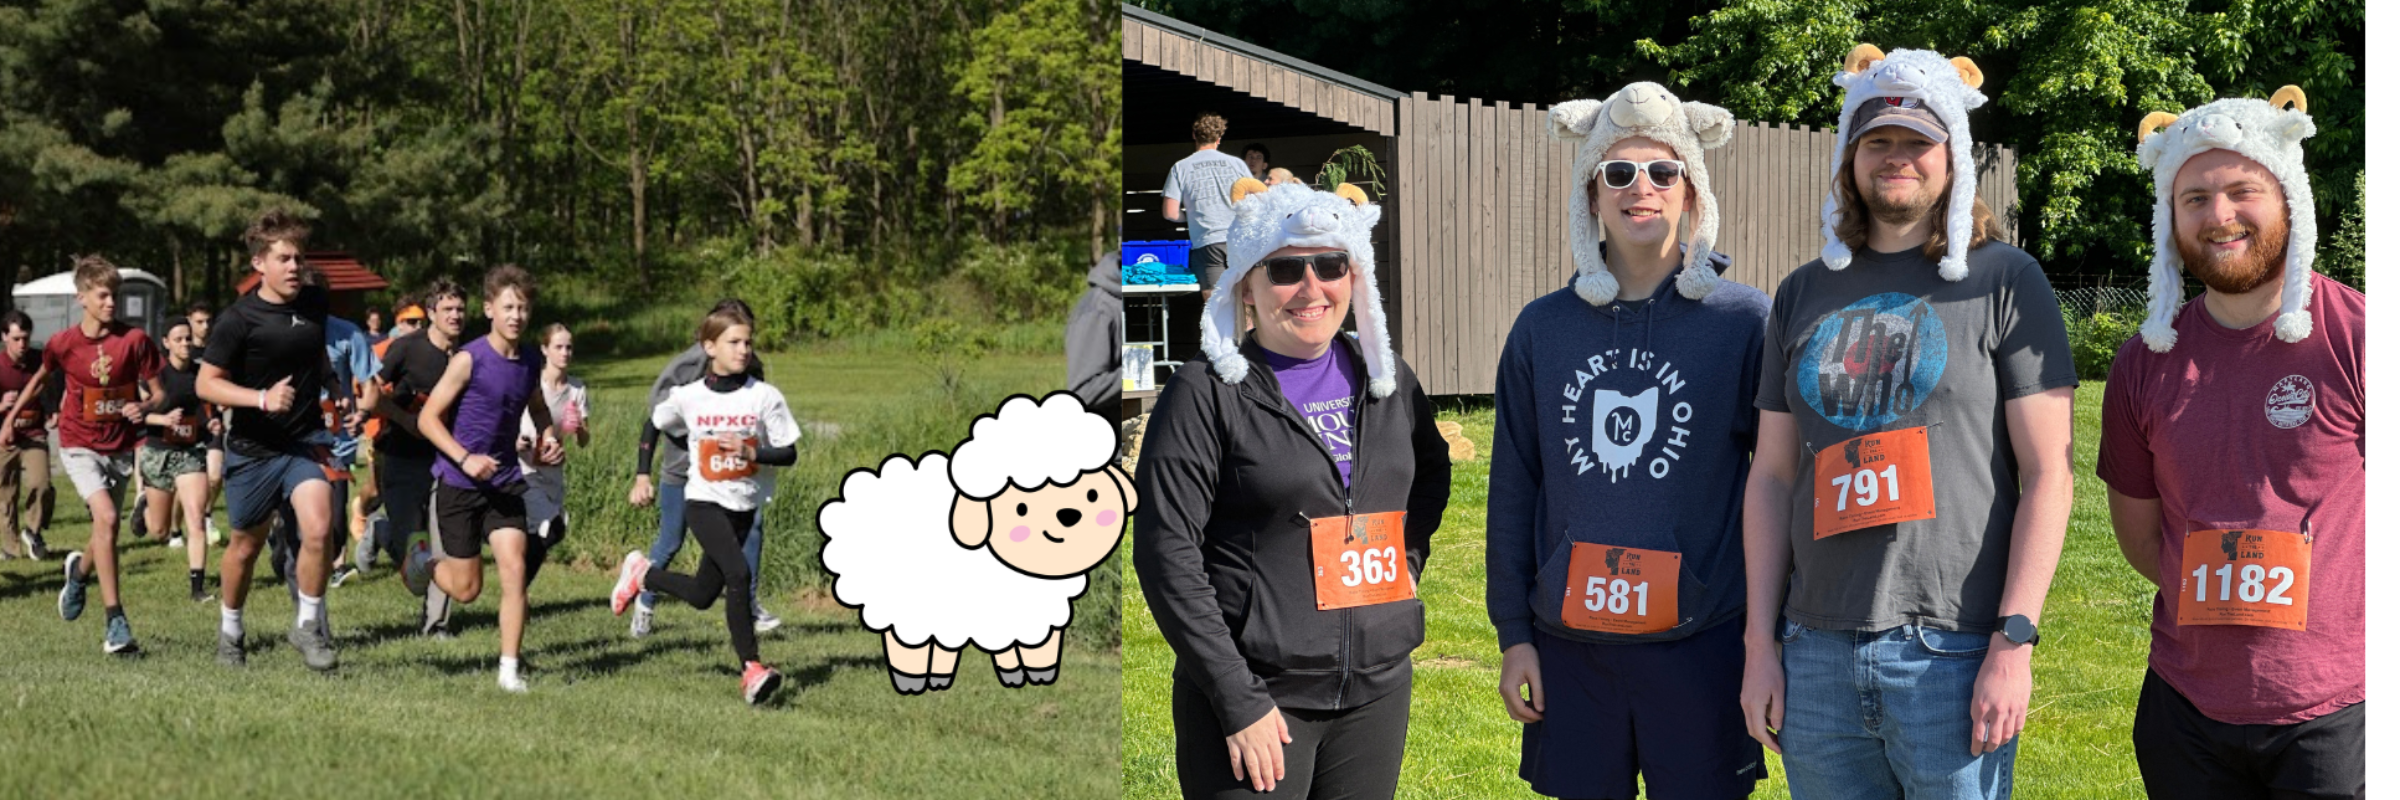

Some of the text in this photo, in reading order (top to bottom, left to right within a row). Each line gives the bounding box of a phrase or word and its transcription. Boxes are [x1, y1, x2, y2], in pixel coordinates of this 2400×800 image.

[1832, 307, 1906, 364] The
[1562, 348, 1693, 479] MY HEART IS IN OHIO
[697, 414, 756, 427] NPXC
[1865, 438, 1881, 447] RUN
[1863, 454, 1885, 464] LAND
[1832, 464, 1899, 512] 791
[2245, 534, 2262, 543] RUN
[1626, 552, 1641, 561] RUN
[2241, 551, 2264, 559] LAND
[1339, 546, 1397, 587] 363
[1621, 567, 1641, 576] LAND
[2192, 563, 2295, 606] 1182
[1585, 576, 1649, 616] 581
